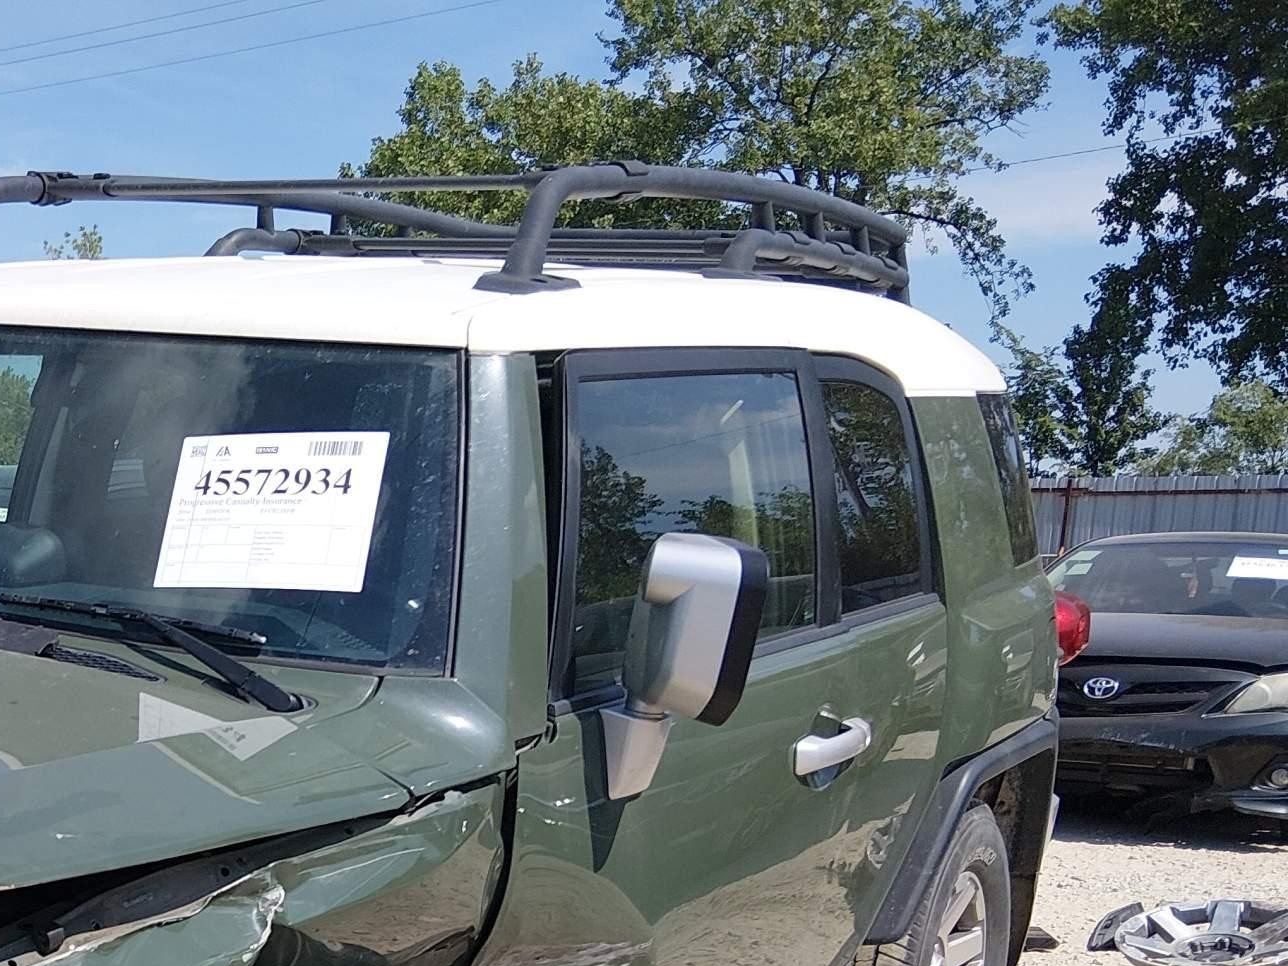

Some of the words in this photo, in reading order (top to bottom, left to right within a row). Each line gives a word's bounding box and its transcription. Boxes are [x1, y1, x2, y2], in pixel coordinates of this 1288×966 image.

[194, 468, 352, 496] 45572934
[179, 498, 223, 506] Progressive
[262, 497, 302, 505] Insurance
